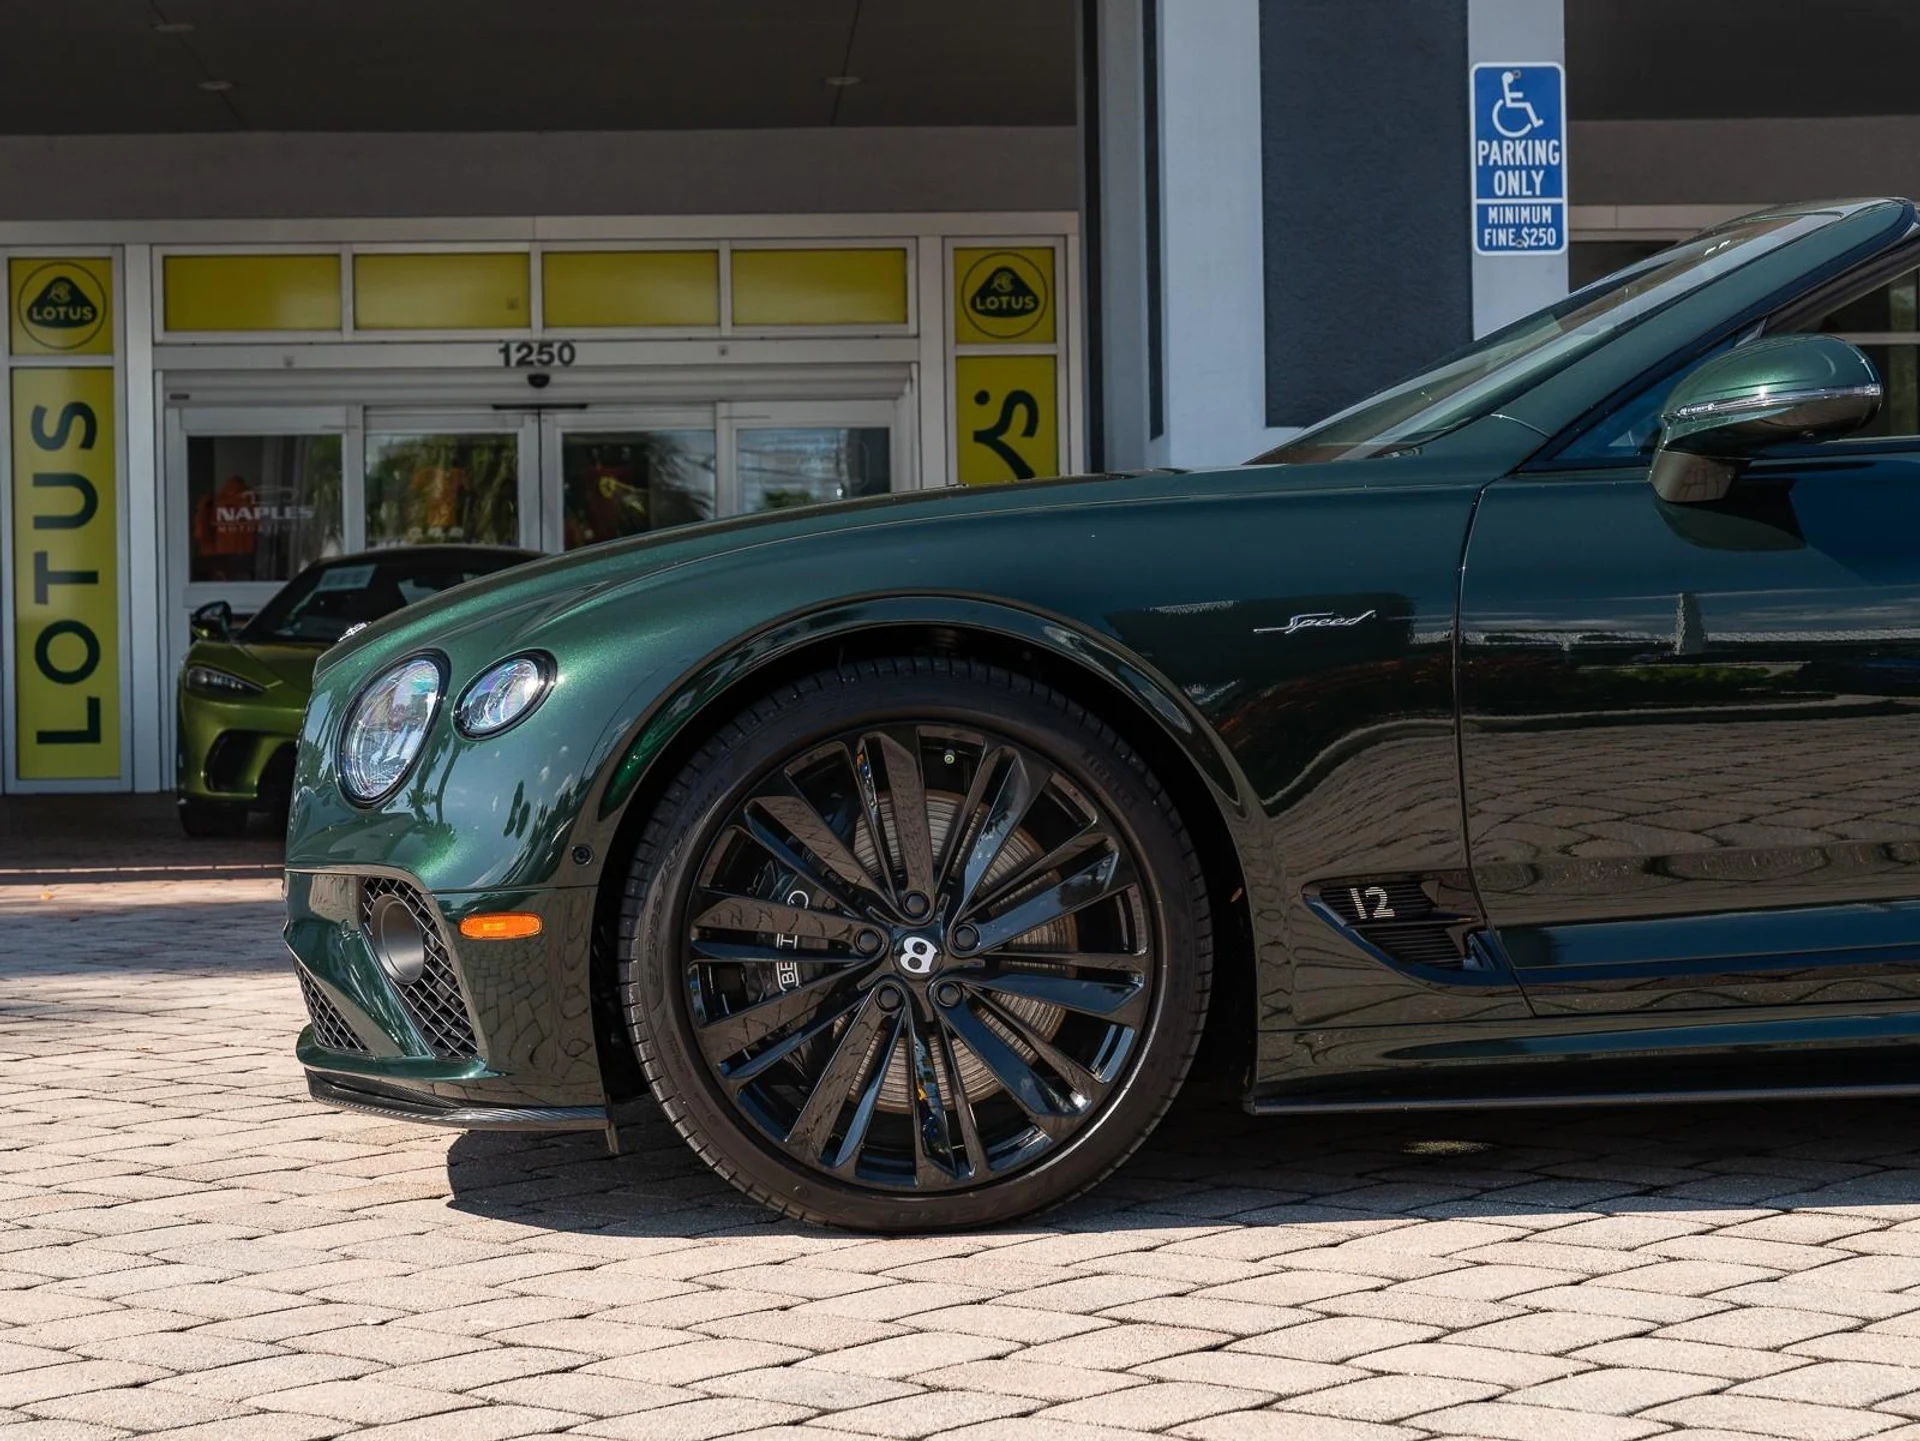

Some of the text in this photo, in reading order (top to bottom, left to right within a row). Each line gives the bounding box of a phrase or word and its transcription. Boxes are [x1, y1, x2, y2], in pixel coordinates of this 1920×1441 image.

[1477, 139, 1560, 166] PARKING
[1493, 170, 1545, 196] ONLY
[1488, 206, 1552, 224] MINIMUM
[1484, 227, 1556, 248] FINE $250
[33, 306, 93, 320] LOTUS
[976, 296, 1035, 310] LOTUS
[499, 341, 576, 367] 1250
[216, 506, 314, 521] NAPLES
[31, 401, 102, 745] LOTUS
[1253, 609, 1376, 634] Speed
[1350, 886, 1395, 919] 12
